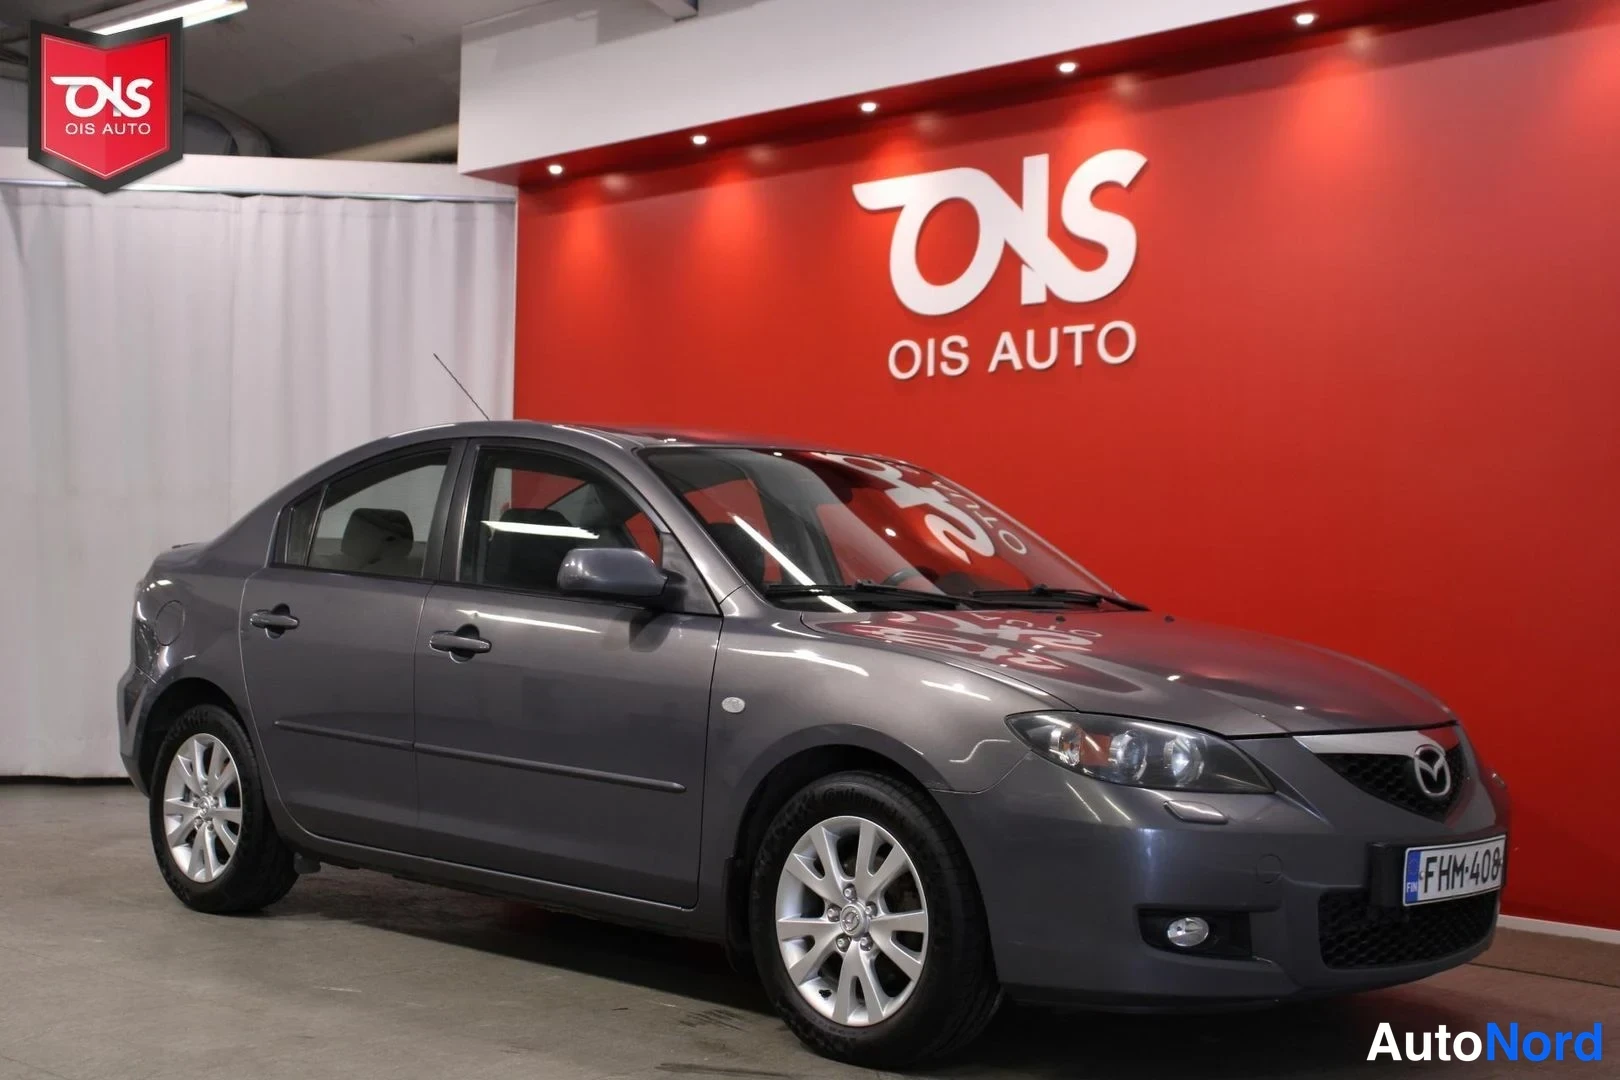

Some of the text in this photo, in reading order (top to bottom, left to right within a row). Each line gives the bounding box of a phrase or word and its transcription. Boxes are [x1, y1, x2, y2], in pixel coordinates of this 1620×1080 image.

[852, 149, 1148, 316] OIS
[888, 320, 1137, 380] OIS AUTO
[1406, 881, 1418, 893] FIN
[1423, 846, 1502, 894] FHM-408
